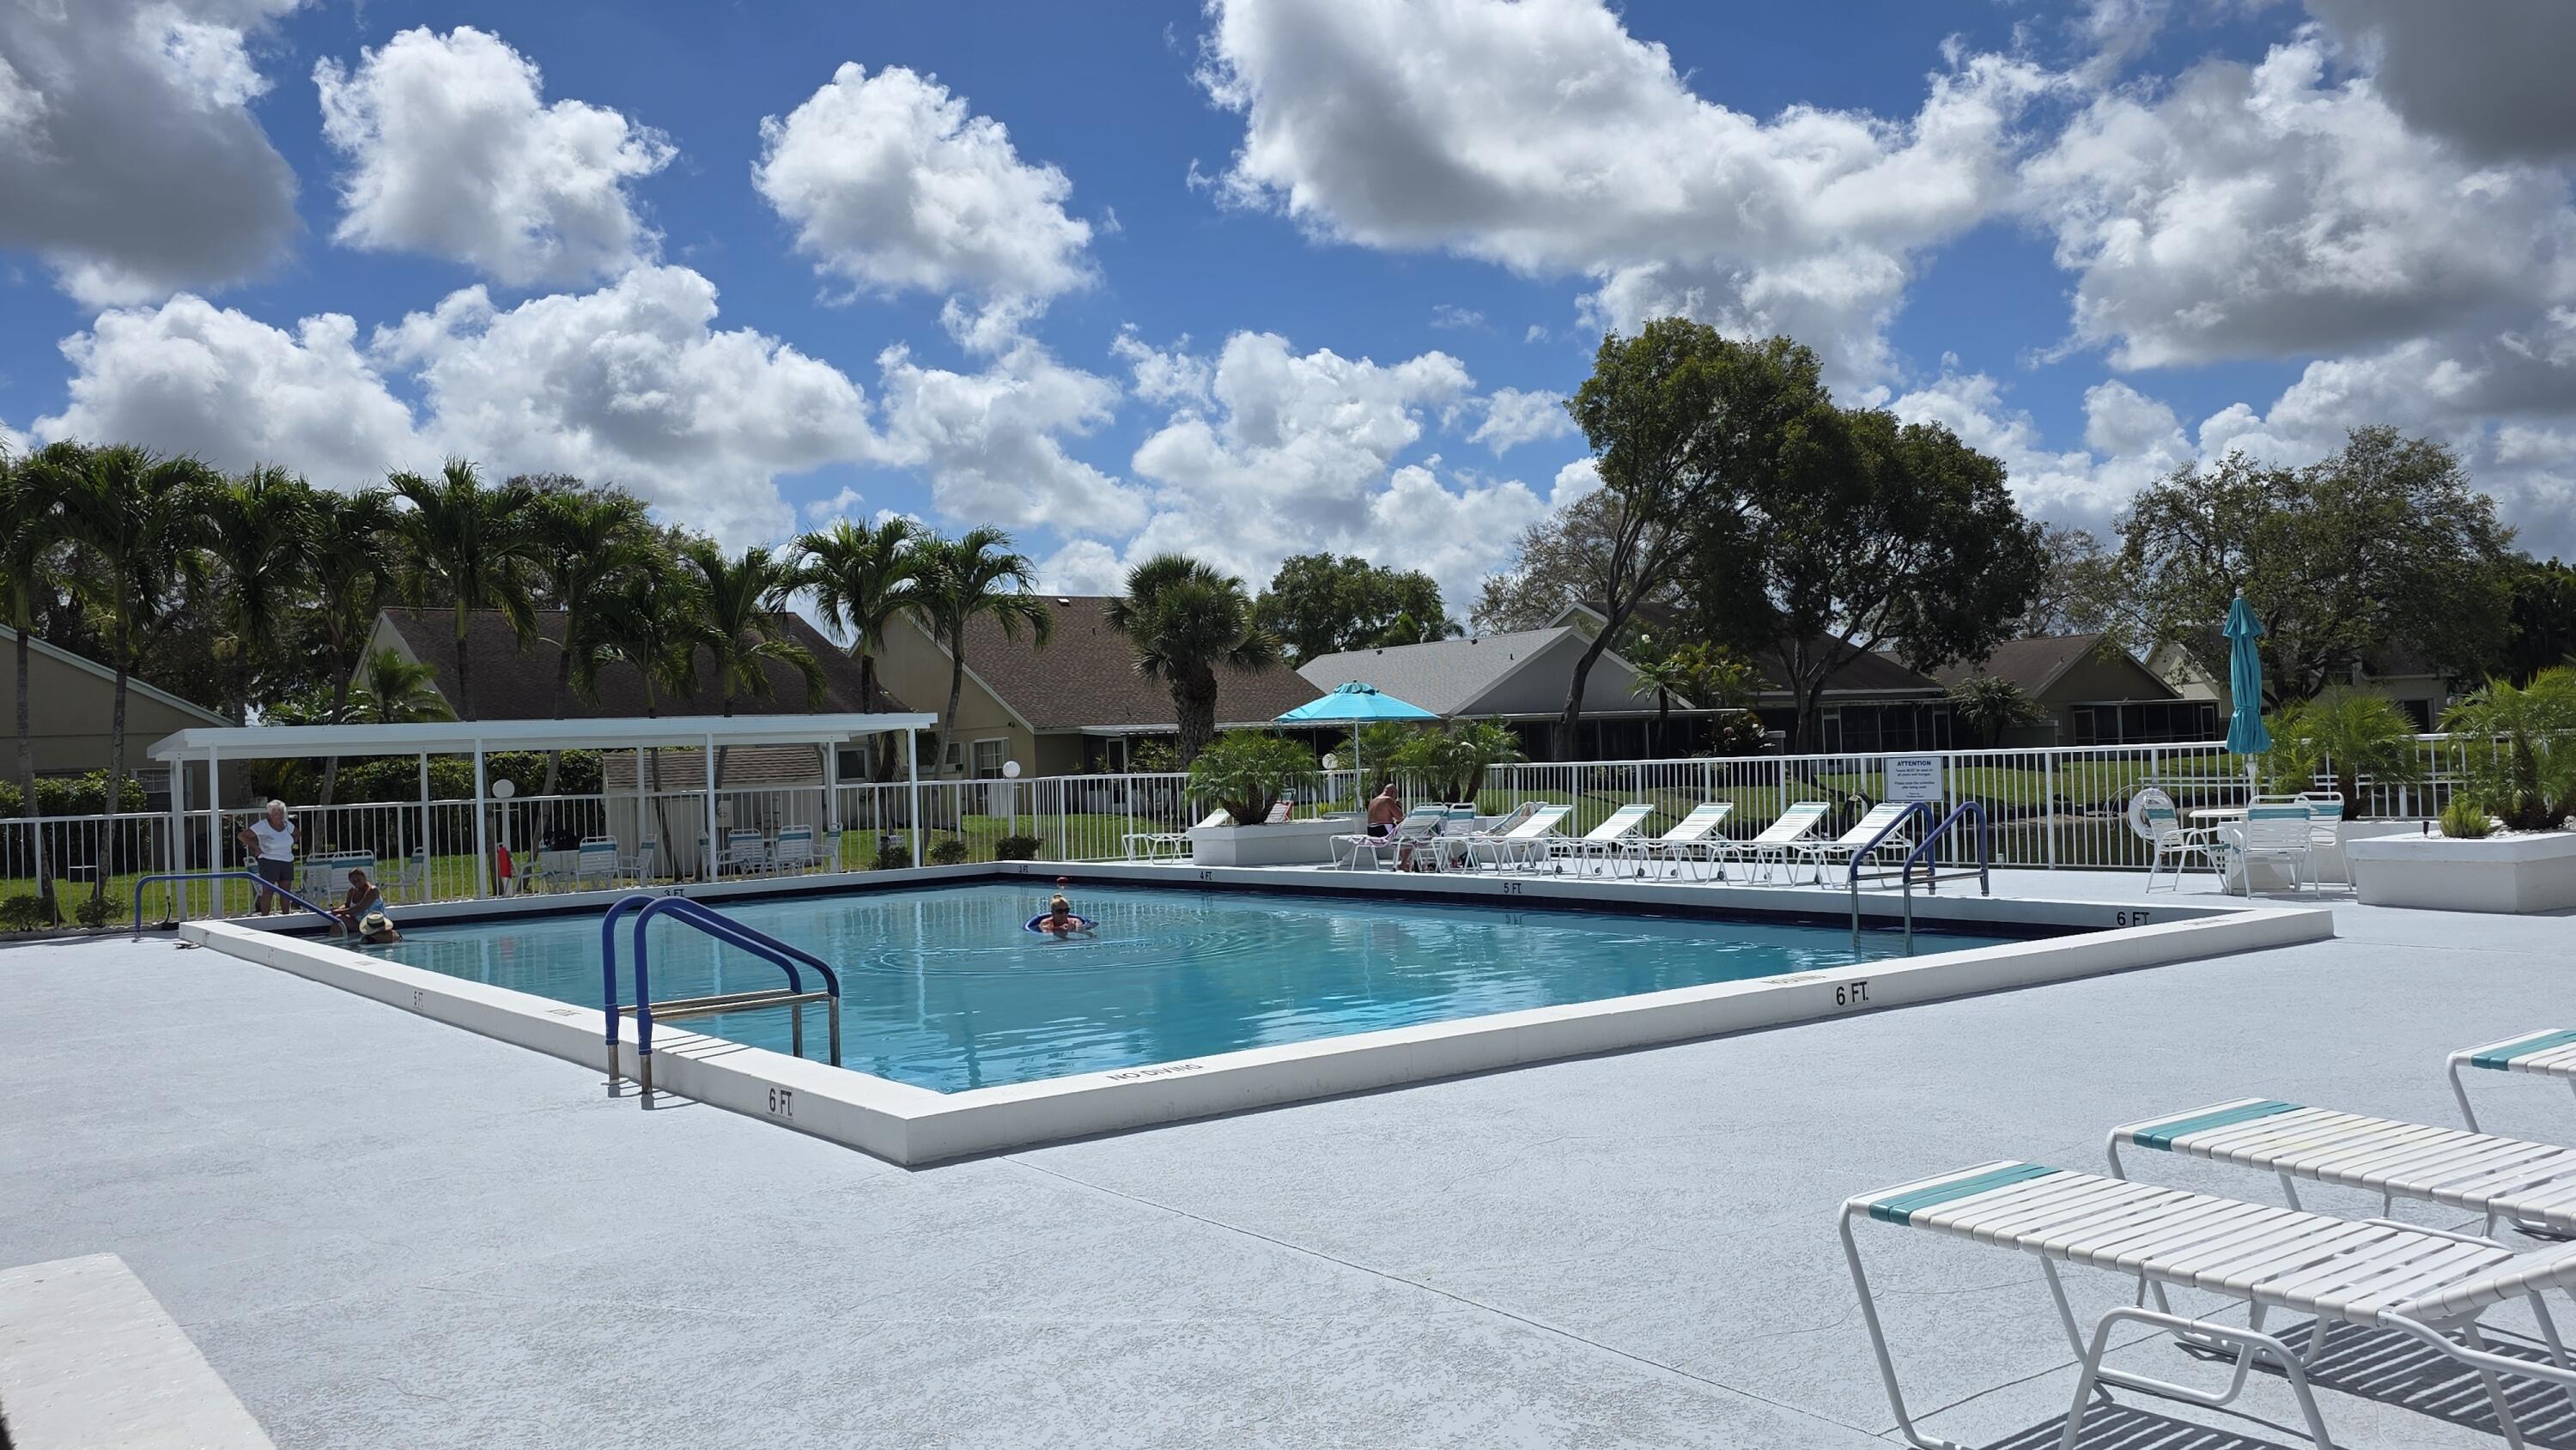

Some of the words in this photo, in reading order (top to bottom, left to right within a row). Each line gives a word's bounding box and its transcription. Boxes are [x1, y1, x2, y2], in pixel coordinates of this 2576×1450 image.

[1200, 871, 1204, 880] 4
[1504, 883, 1510, 894] 5
[2117, 911, 2126, 926] 6
[1836, 986, 1845, 1006] 6
[1850, 981, 1869, 1003] FT.
[1106, 1072, 1140, 1081] NO
[1141, 1064, 1204, 1077] DIVING
[769, 1088, 775, 1113] 6
[781, 1089, 793, 1117] FT.
